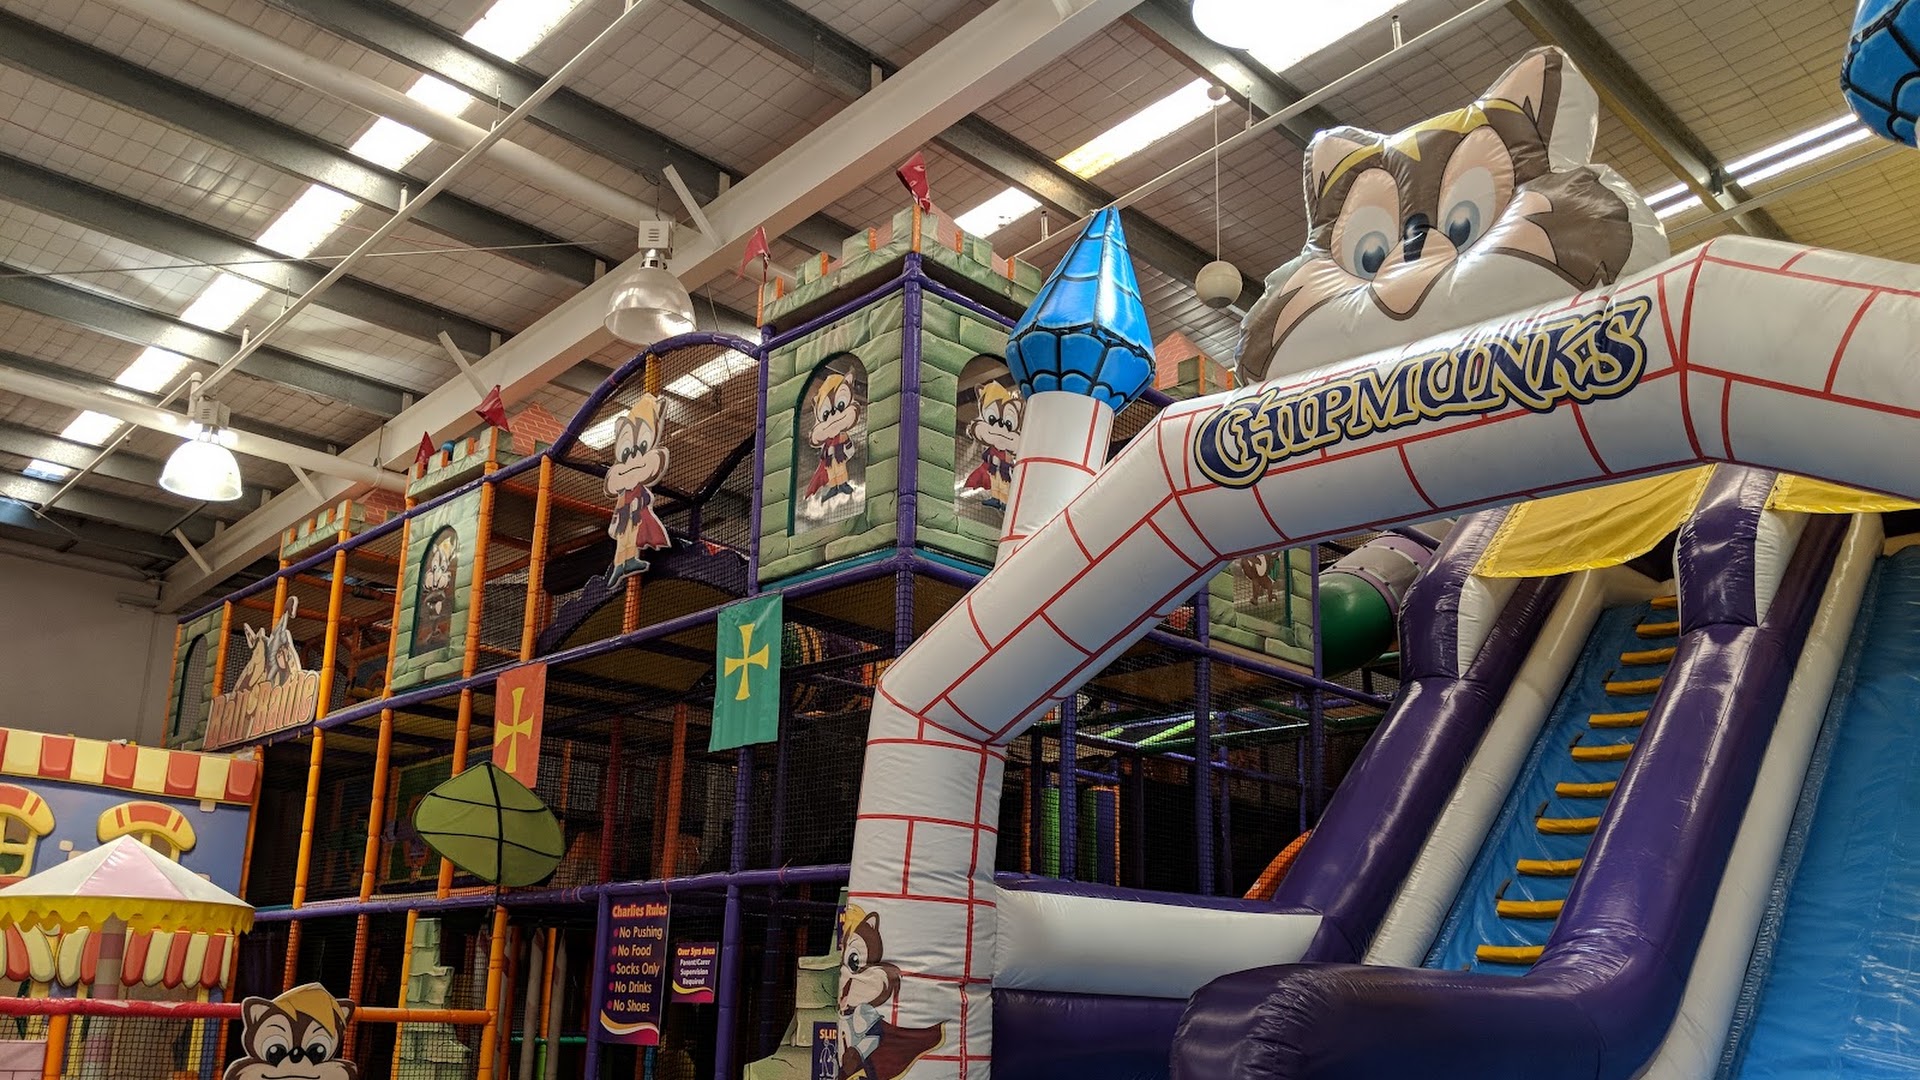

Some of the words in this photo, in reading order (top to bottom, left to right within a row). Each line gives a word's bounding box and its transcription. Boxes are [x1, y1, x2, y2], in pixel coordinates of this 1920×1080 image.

[1194, 295, 1652, 489] CHIPMUNKS
[612, 904, 644, 918] Charlies
[645, 902, 667, 917] Rules
[619, 926, 631, 938] No
[633, 925, 663, 940] Pushing
[617, 944, 630, 957] No
[631, 944, 652, 956] Food
[702, 946, 716, 956] Area
[616, 962, 640, 975] Socks
[641, 962, 660, 978] Only
[680, 968, 709, 977] Supervision
[614, 981, 627, 993] No
[628, 981, 652, 993] Drinks
[682, 977, 705, 987] Required
[612, 999, 625, 1011] No
[626, 999, 650, 1012] Shoes
